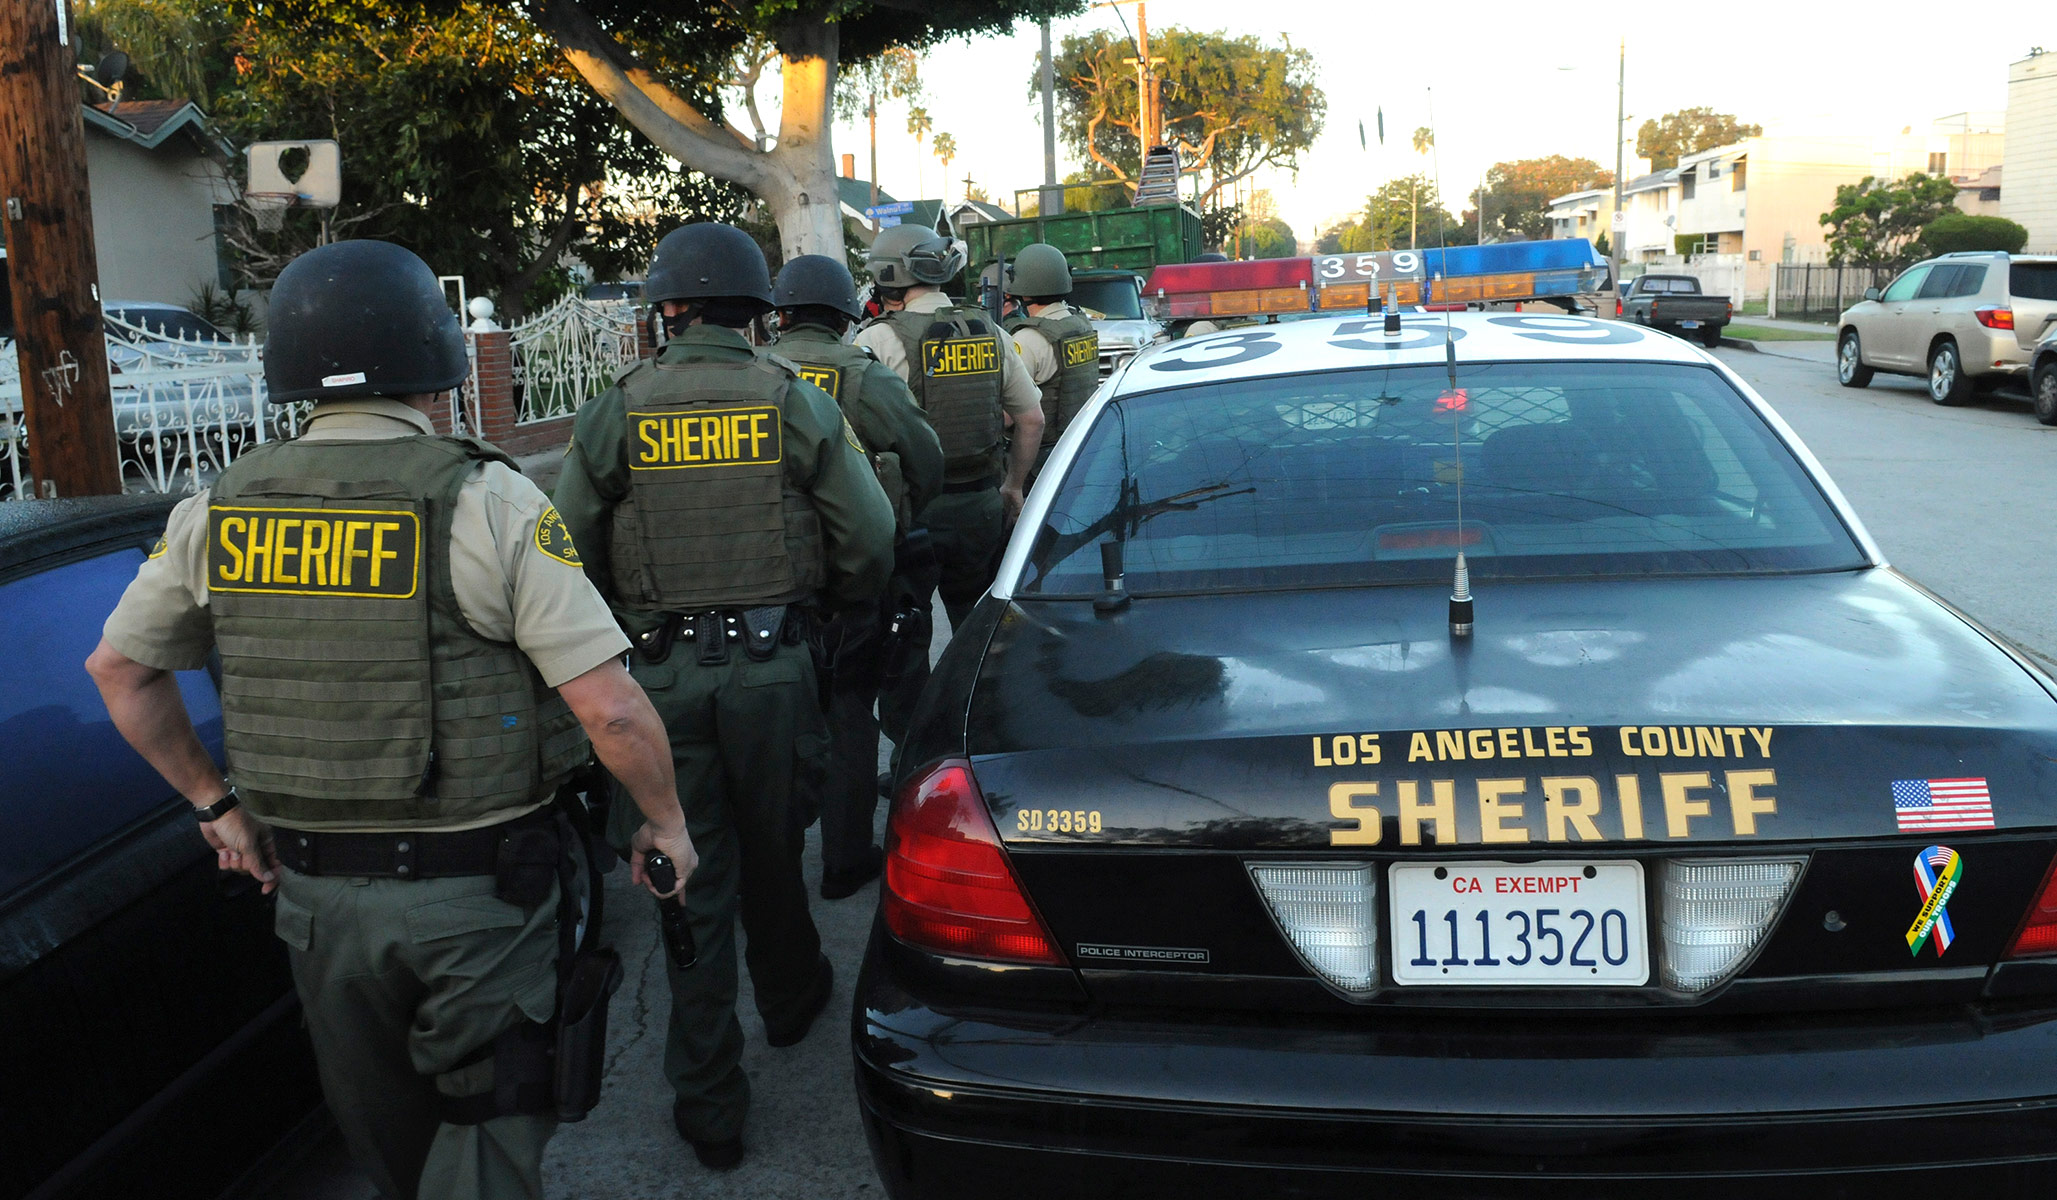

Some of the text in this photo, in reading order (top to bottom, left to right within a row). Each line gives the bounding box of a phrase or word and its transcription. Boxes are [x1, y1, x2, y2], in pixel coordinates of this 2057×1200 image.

[1321, 252, 1419, 278] 359
[1067, 338, 1097, 365] SHERIFF
[639, 414, 769, 463] SHERIFF
[219, 517, 400, 587] SHERIFF
[541, 528, 551, 546] LOS
[1313, 726, 1773, 766] LOS ANGELES COUNTY
[1328, 768, 1778, 846] SHERIFF
[1453, 877, 1582, 894] CA EXEMPT
[1912, 875, 1948, 933] WE SUPPORT
[1919, 880, 1957, 938] OUR TROOPS
[1081, 947, 1205, 961] POLICE INTERCEPTOR
[1411, 909, 1629, 967] 1113520
